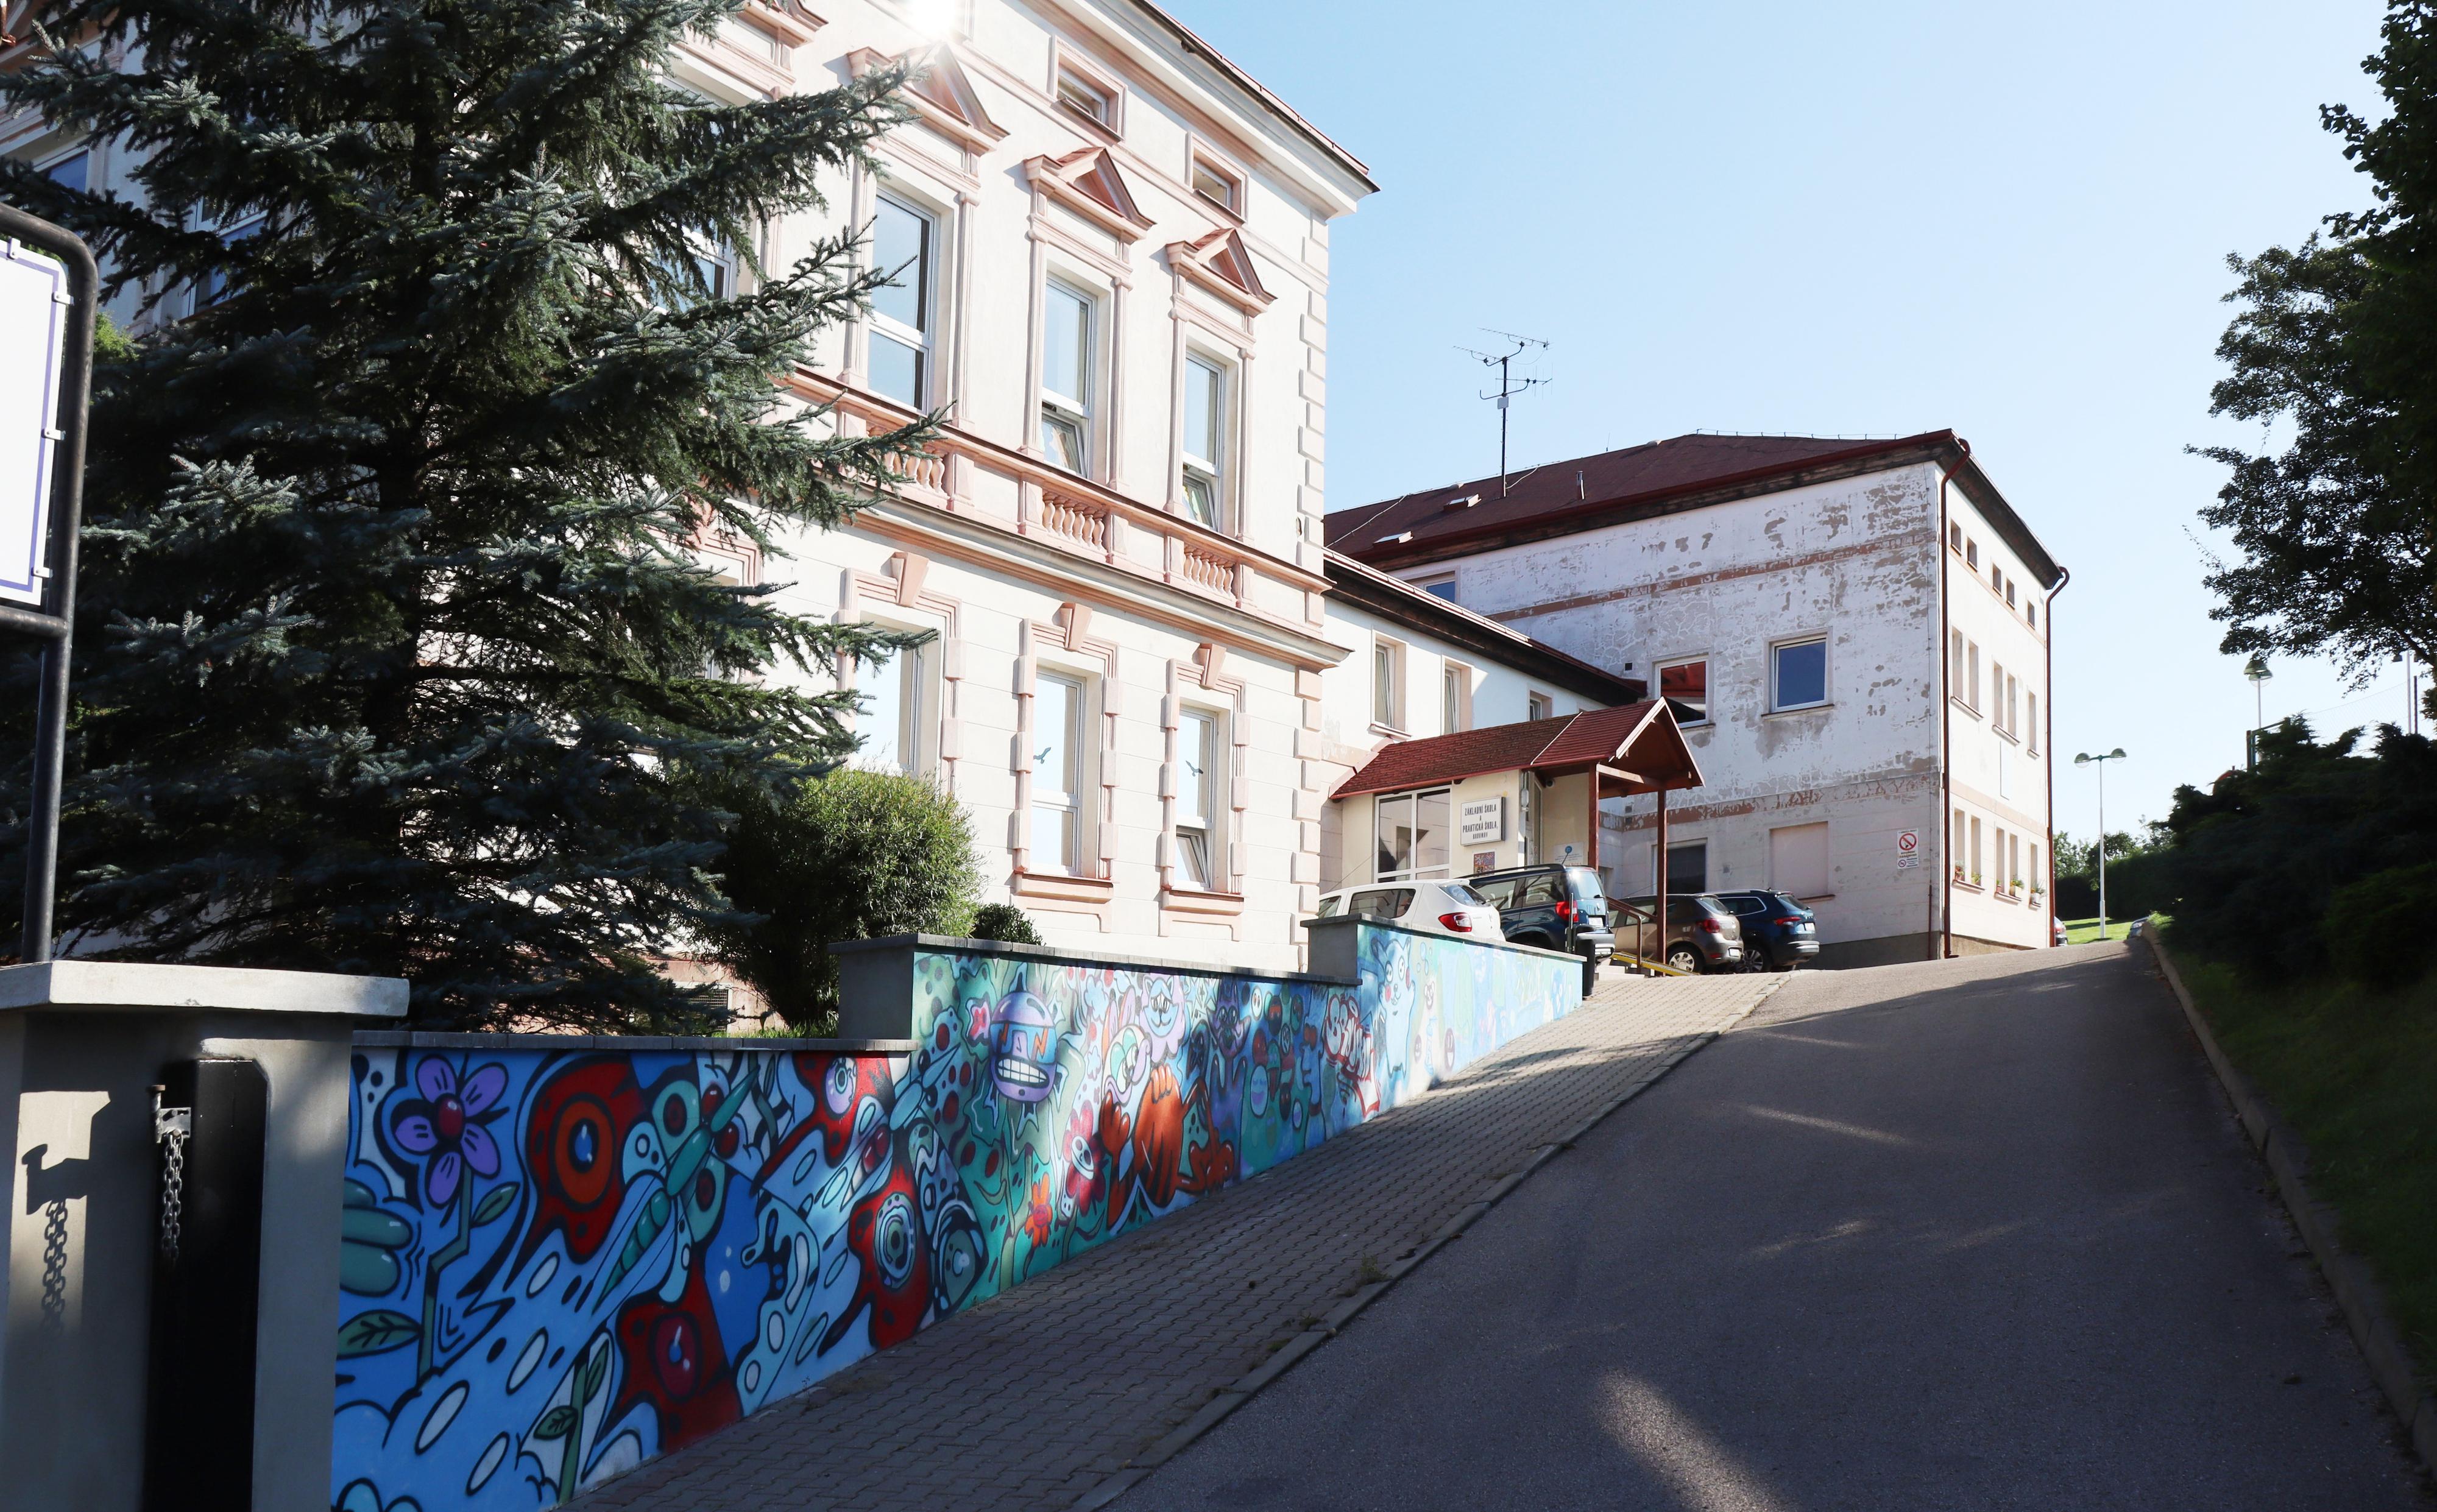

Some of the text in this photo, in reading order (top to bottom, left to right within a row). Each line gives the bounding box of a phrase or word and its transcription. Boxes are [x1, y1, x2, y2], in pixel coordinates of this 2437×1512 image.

[1465, 804, 1496, 816] ZÁKLADNÍ ŠKOLA
[1463, 821, 1498, 833] PRAKTICKÁ ŠKOLA,
